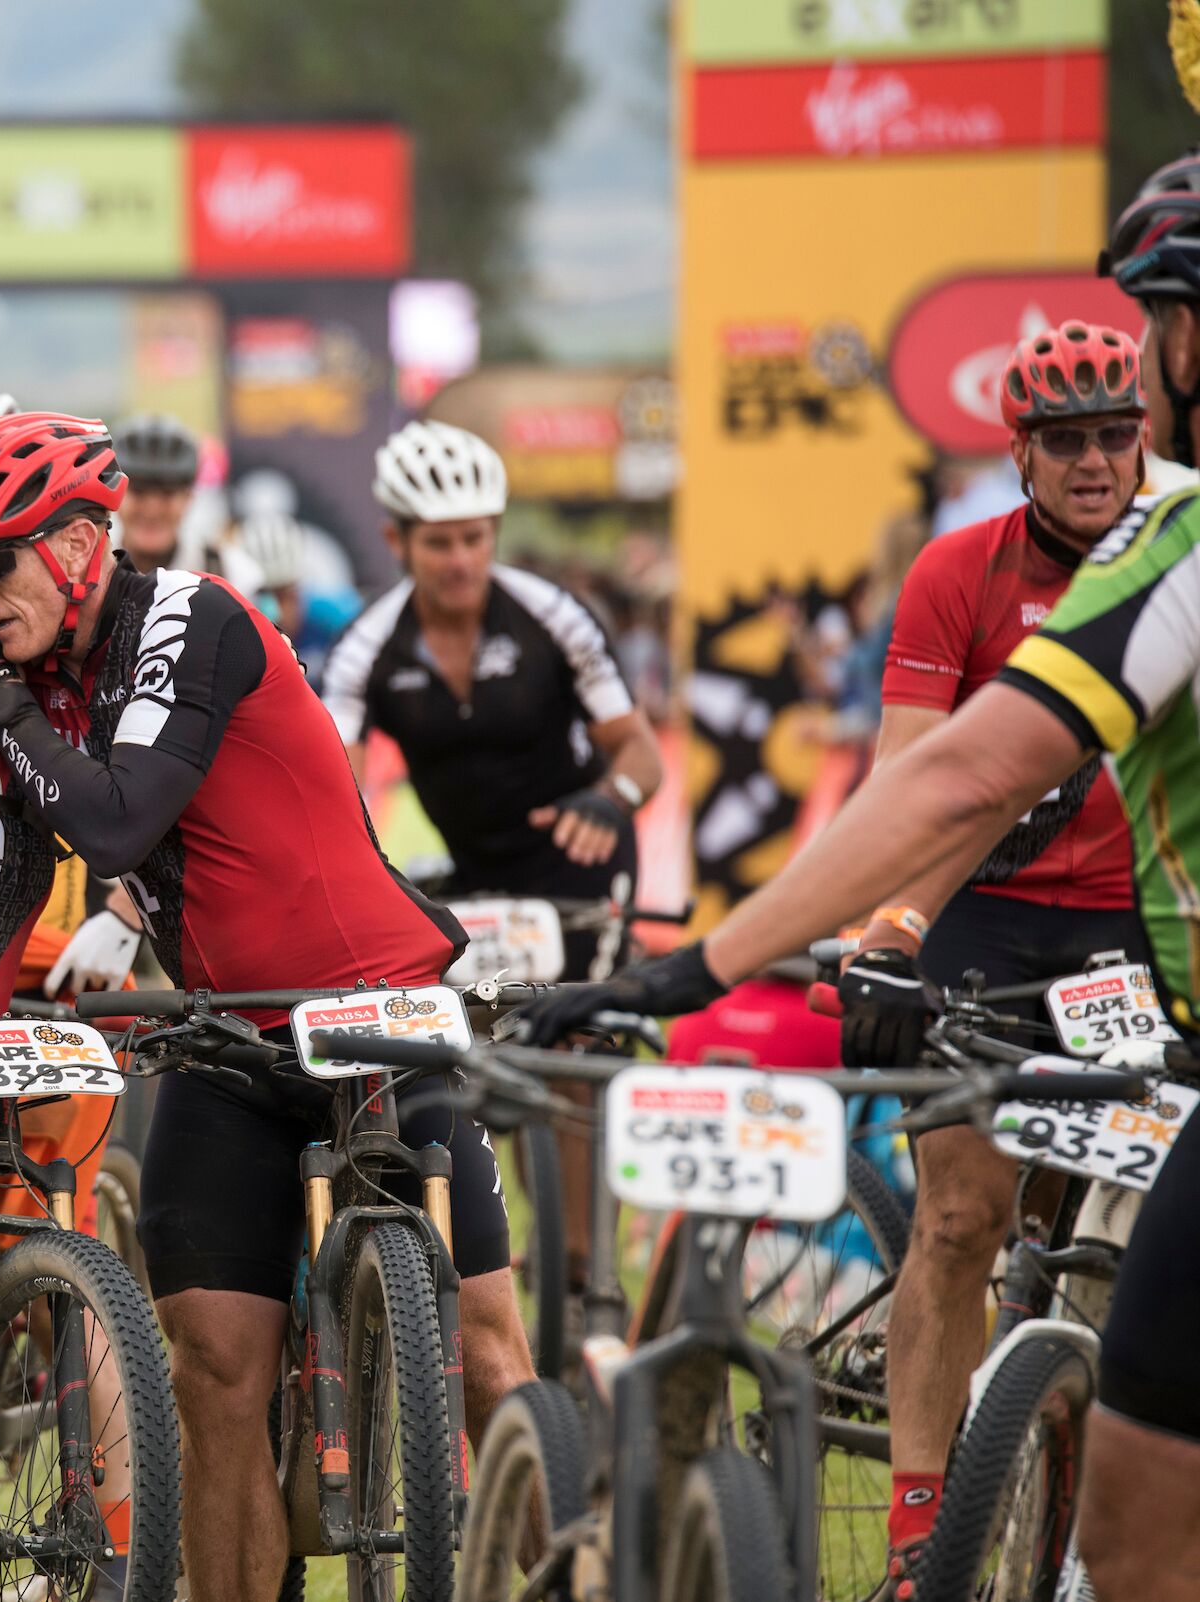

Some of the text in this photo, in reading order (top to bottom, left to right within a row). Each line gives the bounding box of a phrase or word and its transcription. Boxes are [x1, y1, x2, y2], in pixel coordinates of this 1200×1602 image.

[333, 1010, 374, 1021] ABSA
[1064, 995, 1132, 1020] CAPE
[387, 1012, 455, 1037] EPIC
[1089, 1013, 1170, 1041] 319-
[39, 1045, 105, 1062] EPIC
[1017, 1117, 1157, 1182] 93-2
[667, 1154, 788, 1196] 93-1
